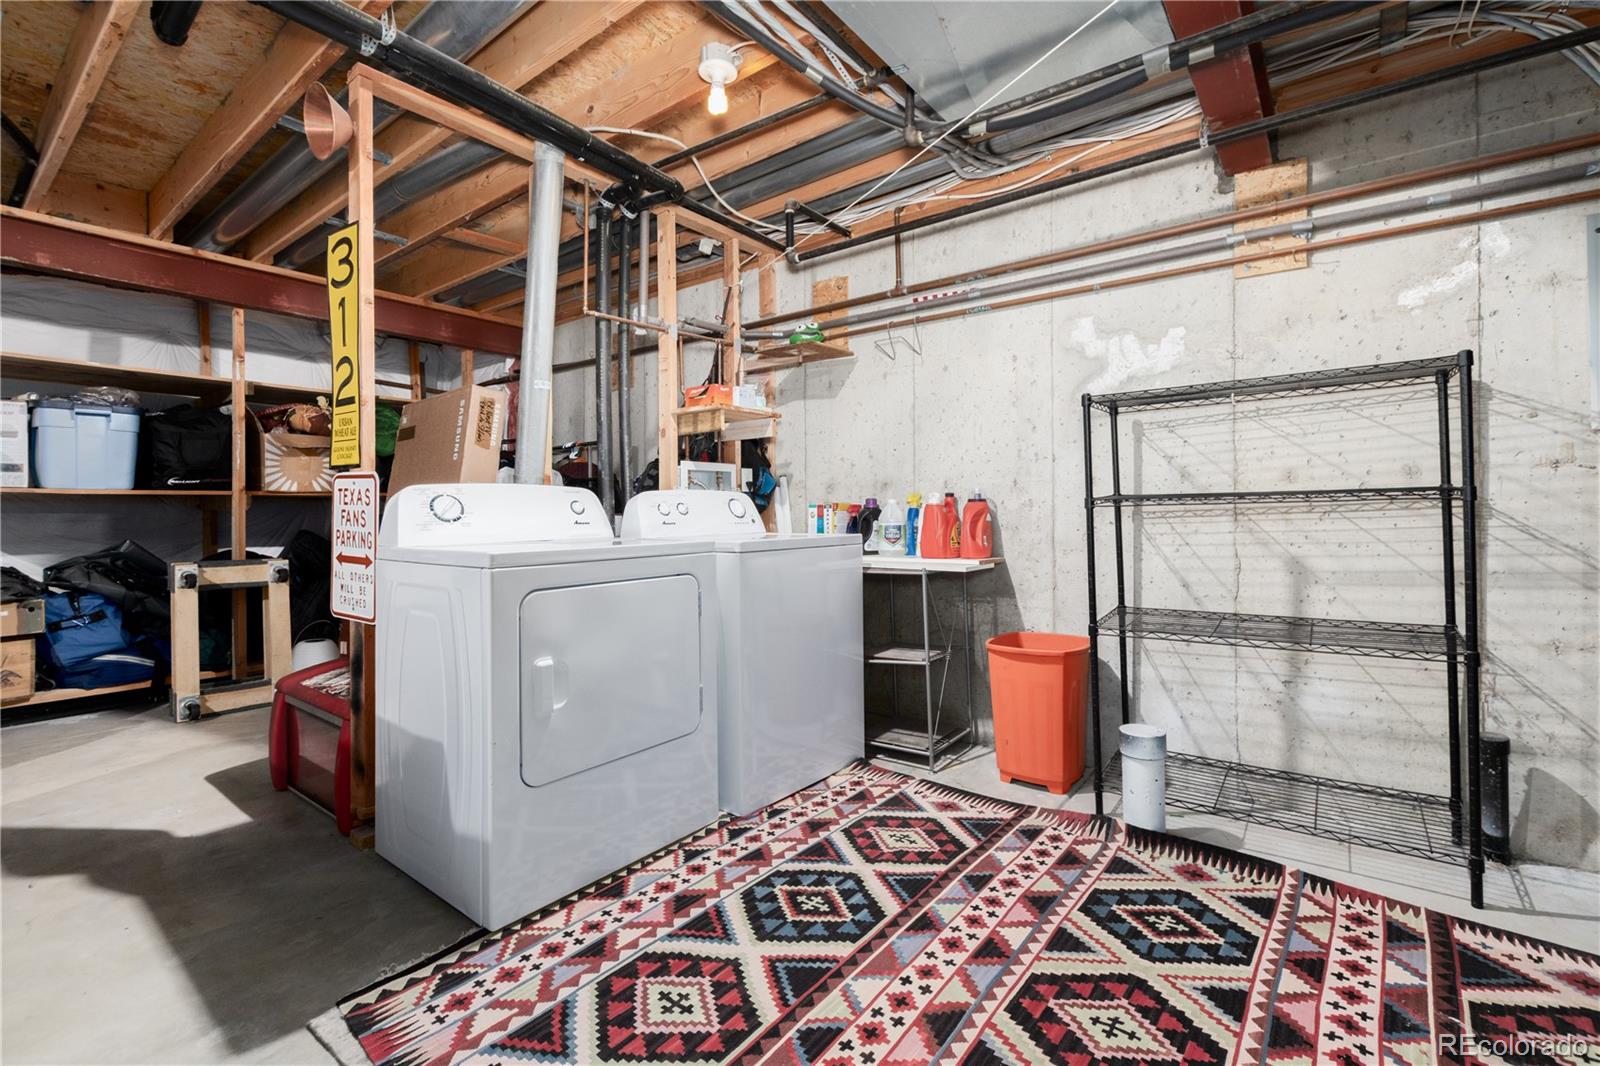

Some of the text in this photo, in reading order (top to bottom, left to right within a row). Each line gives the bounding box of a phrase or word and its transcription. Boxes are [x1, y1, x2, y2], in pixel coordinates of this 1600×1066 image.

[452, 399, 466, 461] SAMSUNG
[337, 487, 371, 506] TEXAS
[341, 508, 367, 528] FANS
[335, 529, 373, 550] PARKING
[335, 569, 374, 584] ALL OTHERS
[340, 583, 367, 596] WILL BE
[339, 594, 367, 608] CRUSHED
